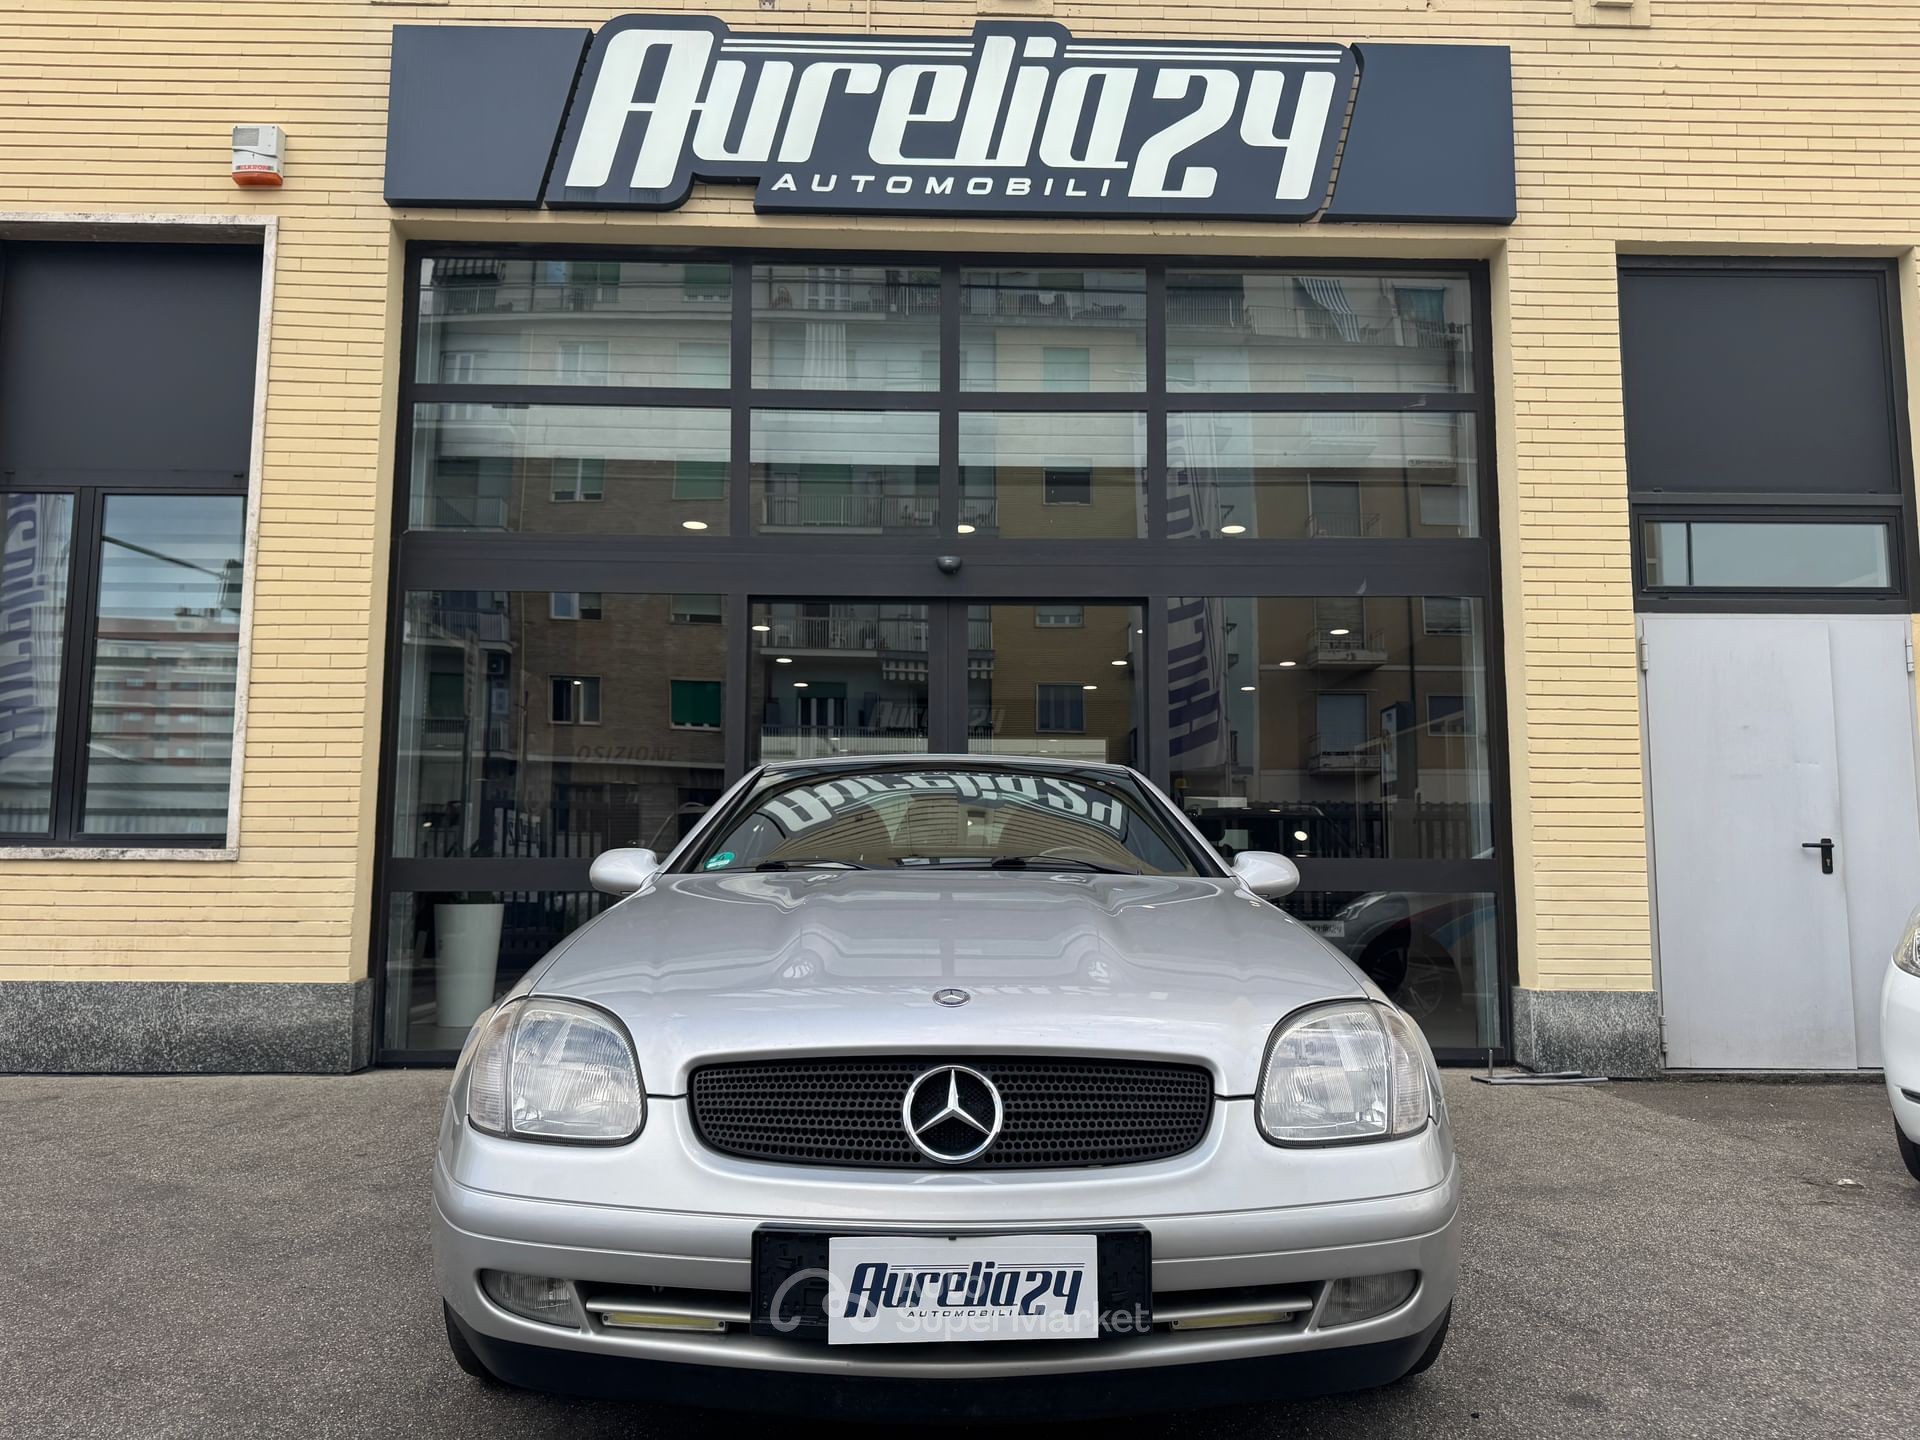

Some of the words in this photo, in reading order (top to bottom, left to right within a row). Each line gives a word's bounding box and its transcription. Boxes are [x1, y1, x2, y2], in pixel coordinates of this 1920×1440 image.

[565, 29, 1336, 200] Aurelia24
[771, 174, 1111, 197] AUTOMOBILI
[844, 1261, 1083, 1318] Aurelia24
[907, 1309, 1013, 1318] AUTOMOBILI
